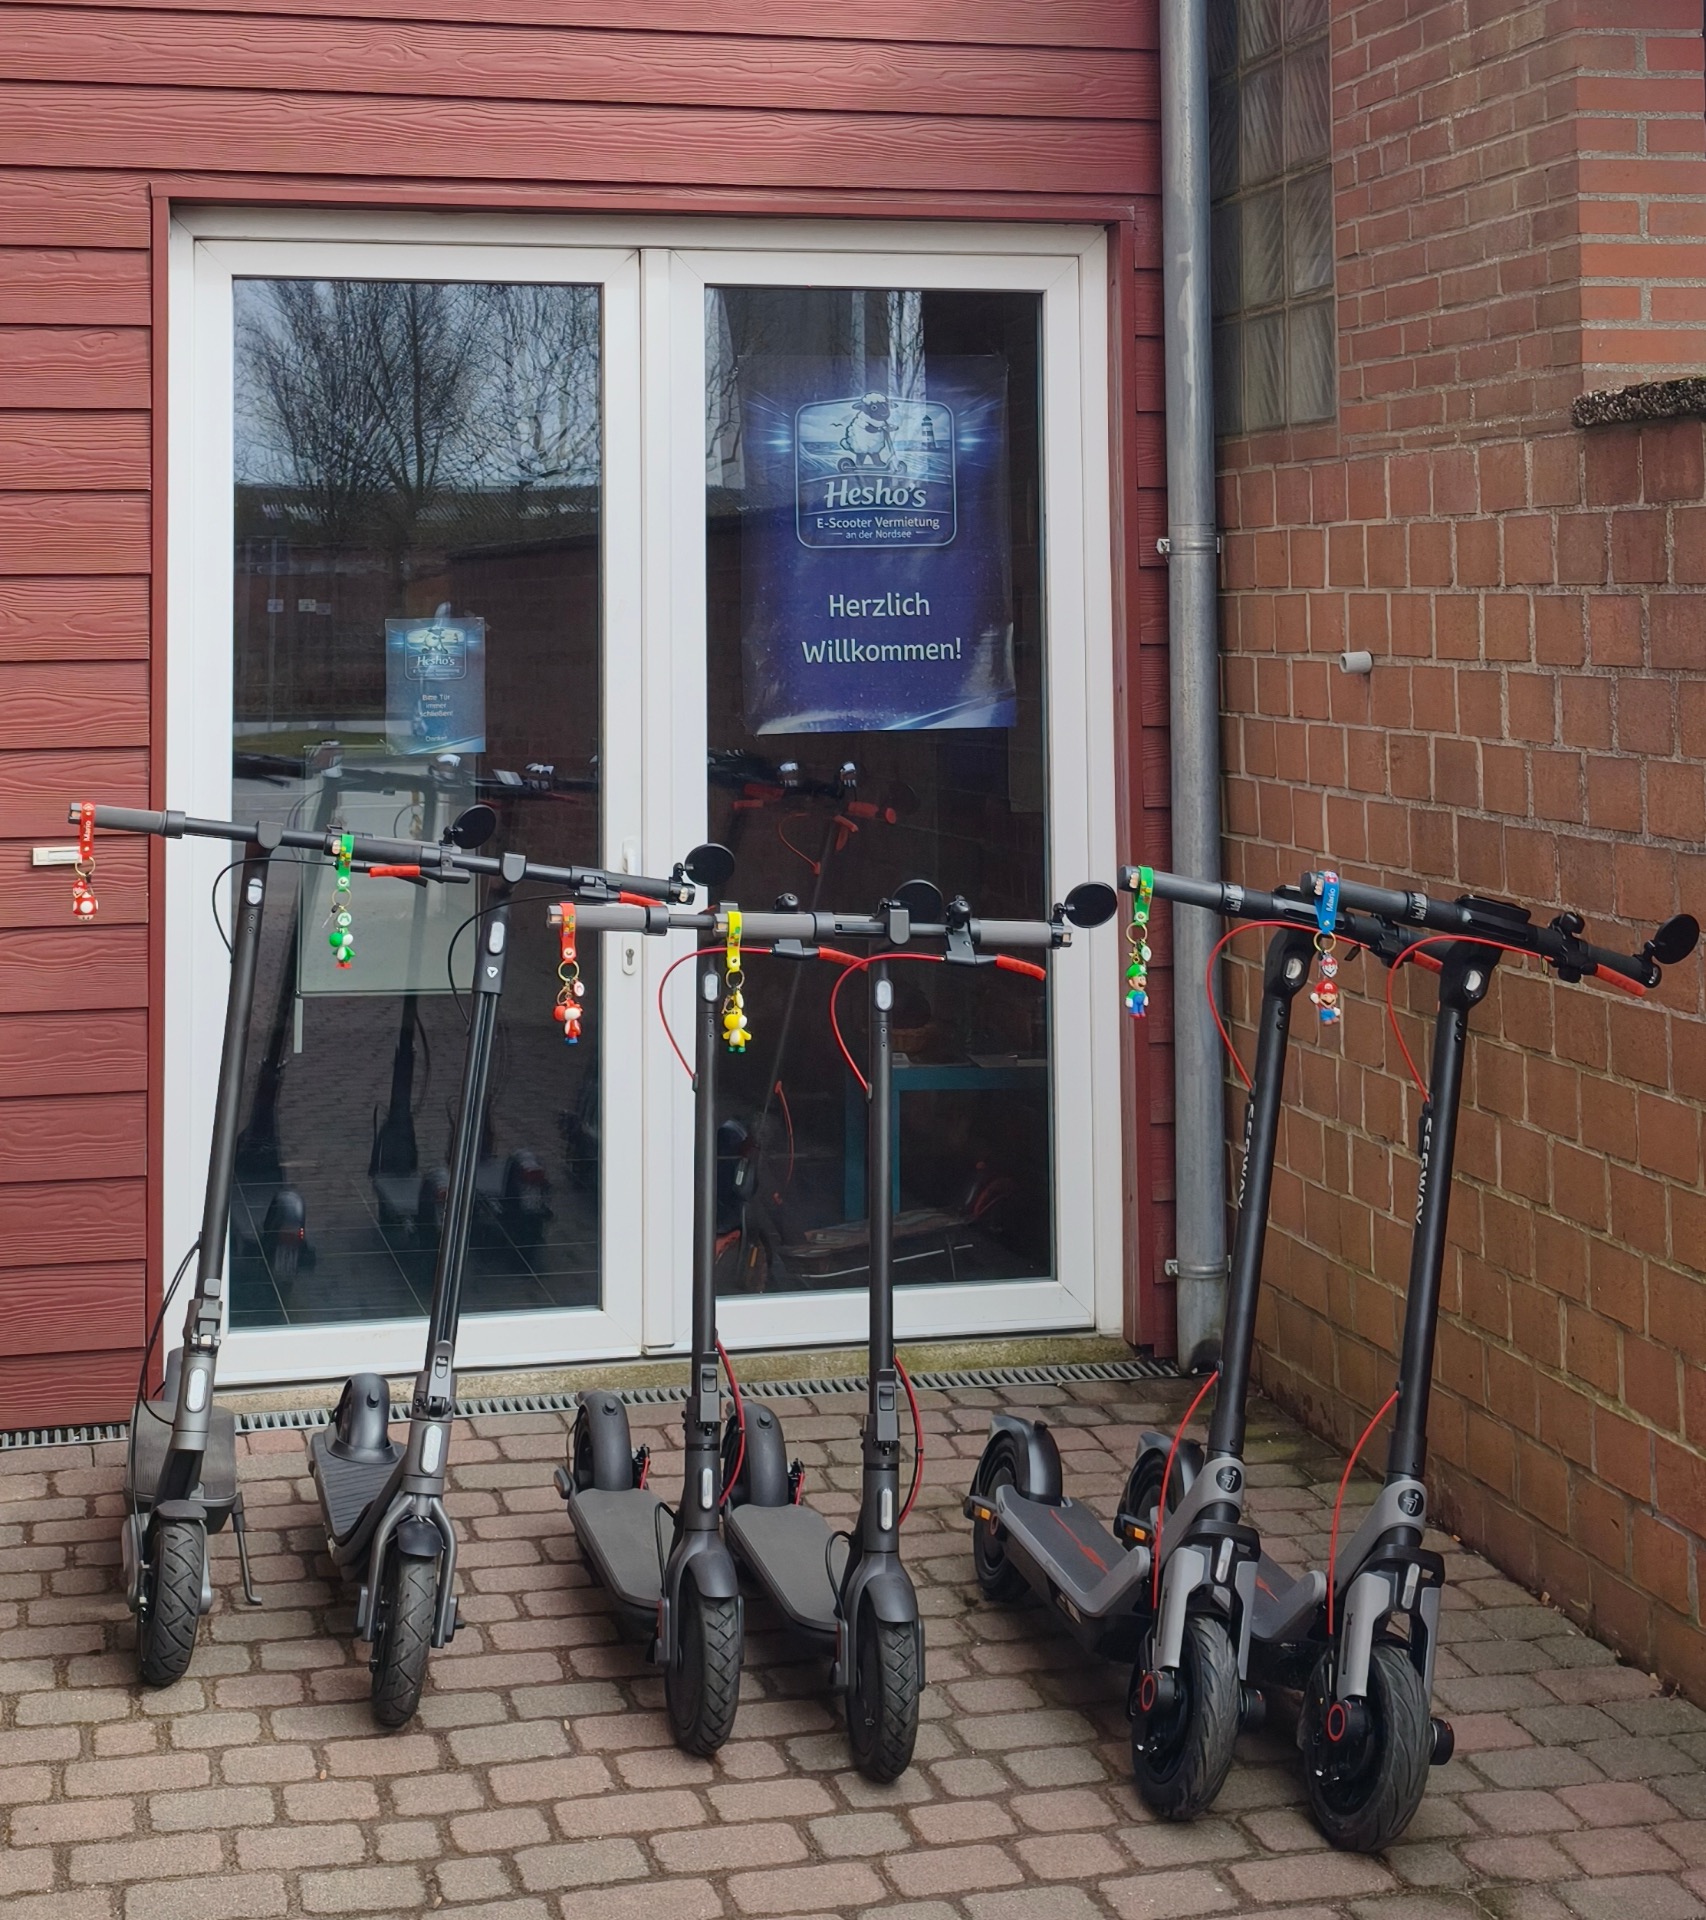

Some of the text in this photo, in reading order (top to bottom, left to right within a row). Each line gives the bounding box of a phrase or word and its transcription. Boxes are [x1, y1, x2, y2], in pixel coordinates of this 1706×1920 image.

[823, 478, 927, 508] Hesho's
[816, 516, 940, 530] E-Scooter Vermietung
[858, 530, 873, 539] der
[875, 530, 912, 539] Nordsee
[828, 591, 931, 617] Herzlich
[801, 637, 962, 664] Willkommen!
[83, 820, 92, 842] Mario
[1325, 887, 1336, 913] Mario
